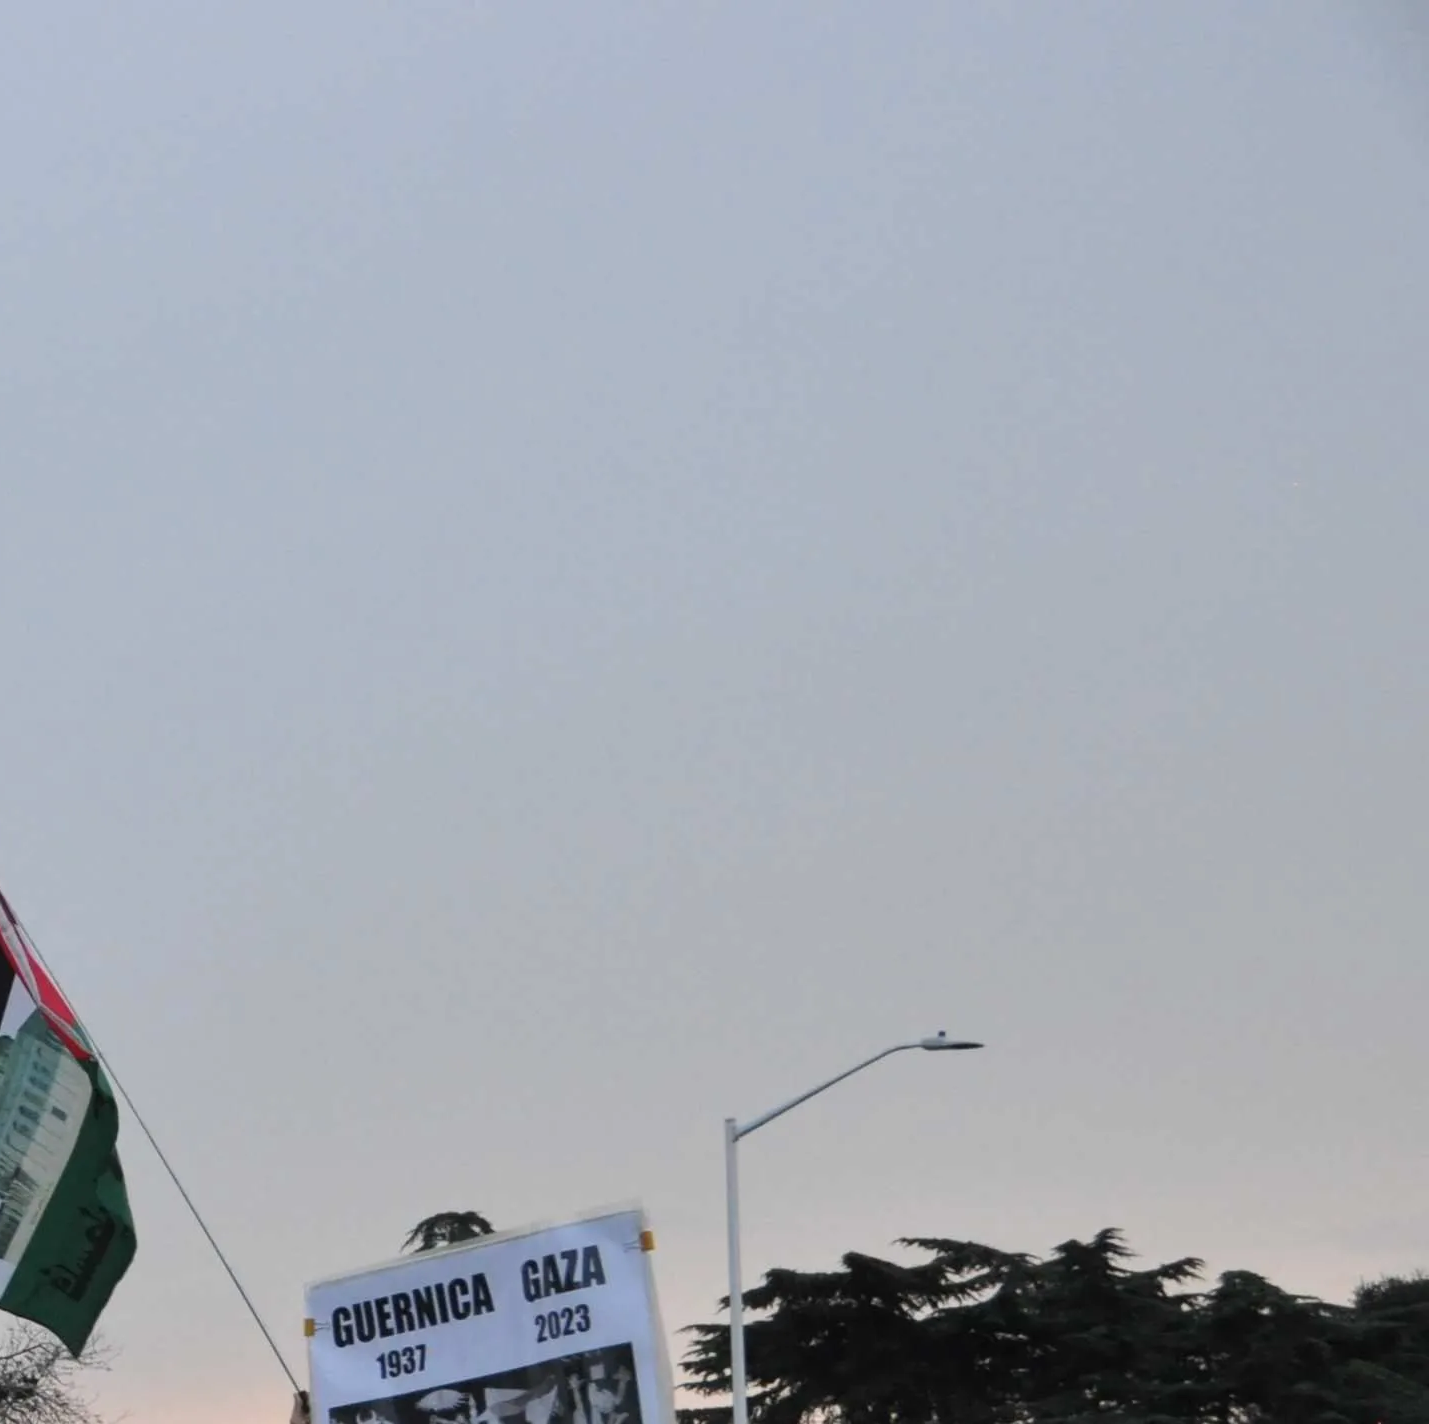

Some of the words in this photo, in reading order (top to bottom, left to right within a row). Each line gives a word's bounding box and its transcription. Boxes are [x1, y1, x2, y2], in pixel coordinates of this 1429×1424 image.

[331, 1272, 495, 1348] GUERNICA
[521, 1245, 607, 1302] GAZA
[376, 1344, 427, 1379] 1937
[535, 1304, 590, 1343] 2023
